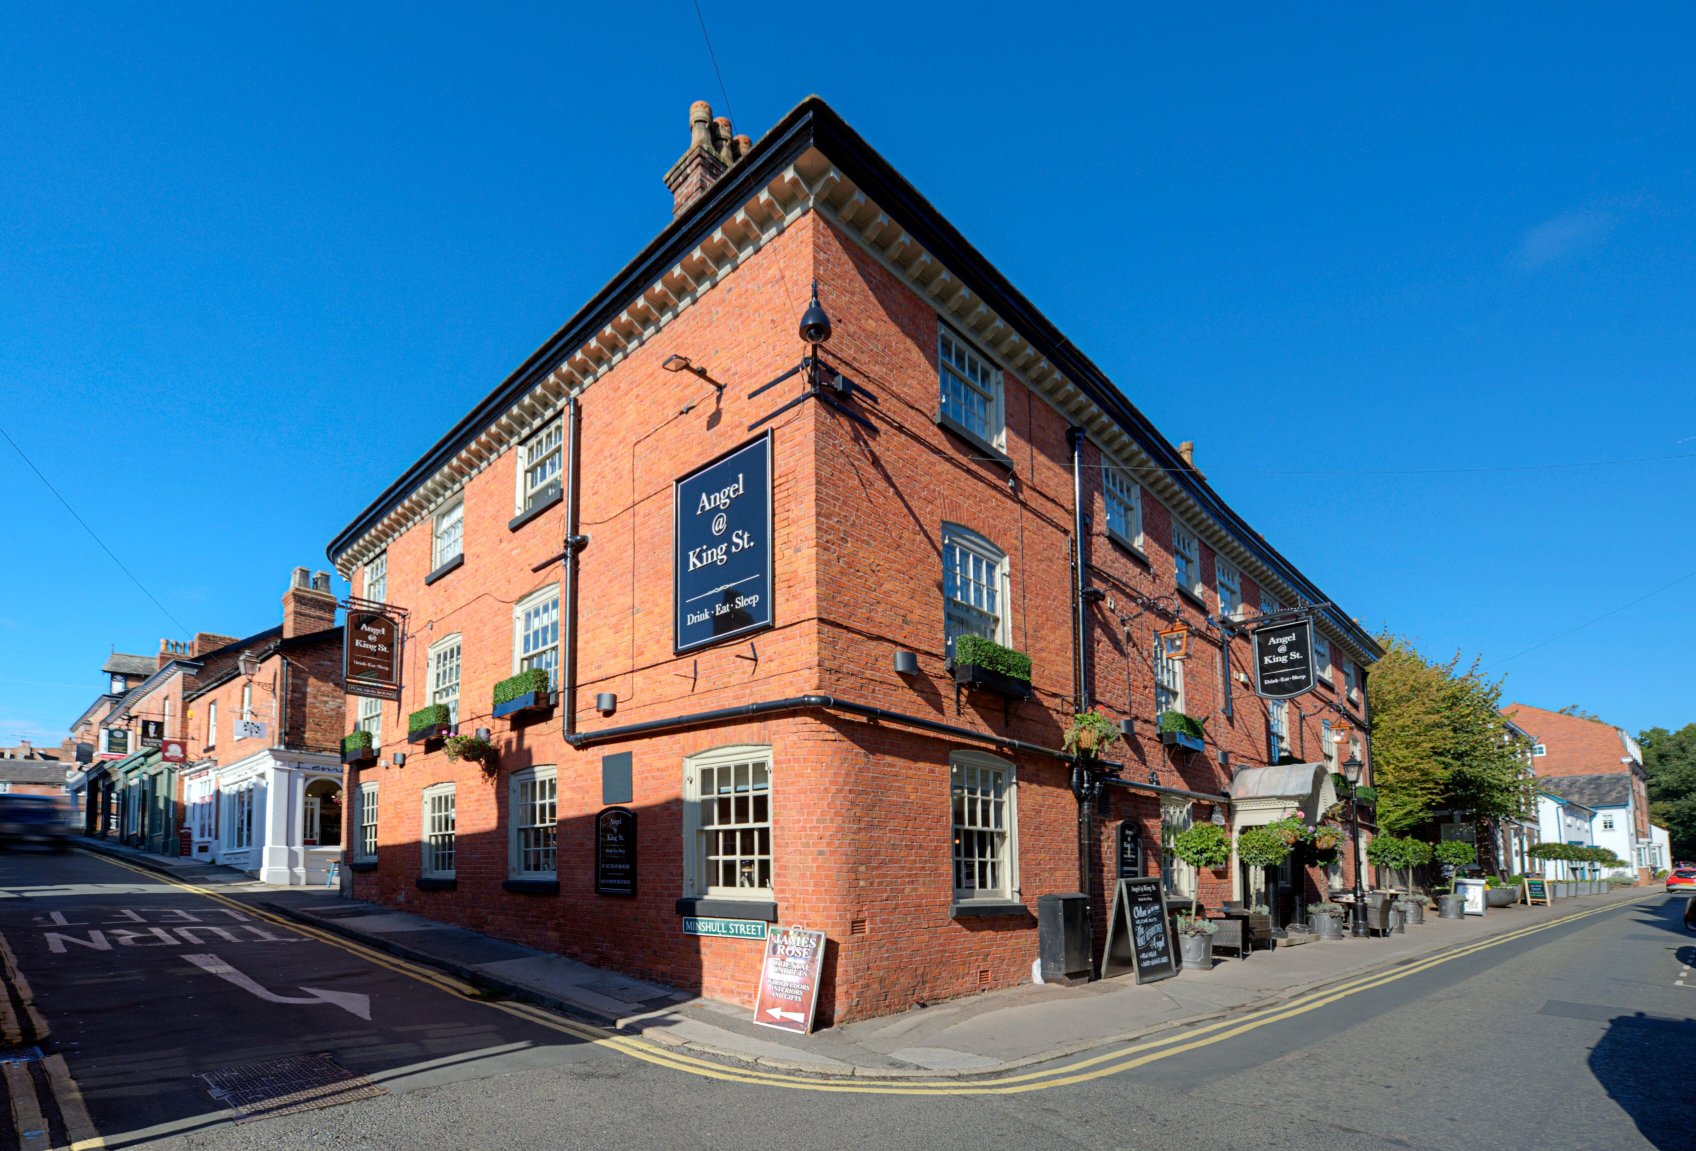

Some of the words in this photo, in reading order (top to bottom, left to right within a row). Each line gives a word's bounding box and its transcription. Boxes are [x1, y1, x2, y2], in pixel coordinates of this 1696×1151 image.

[696, 473, 744, 515] Angel
[711, 512, 727, 536] @
[687, 543, 728, 571] King
[731, 529, 754, 553] St.
[686, 609, 710, 626] Drink
[714, 602, 730, 617] Eat
[735, 593, 759, 610] Sleep
[360, 623, 386, 635] Angel
[355, 639, 377, 652] King
[377, 643, 390, 653] St.
[1267, 632, 1296, 645] Angel
[1277, 644, 1287, 653] @
[1263, 655, 1288, 664] King
[1289, 651, 1303, 660] St.
[37, 909, 252, 928] LEFT
[685, 920, 727, 933] MINSHULL
[729, 923, 763, 936] STREET
[43, 925, 317, 953] TURN
[774, 933, 817, 949] JAMES
[777, 945, 810, 959] ROSE
